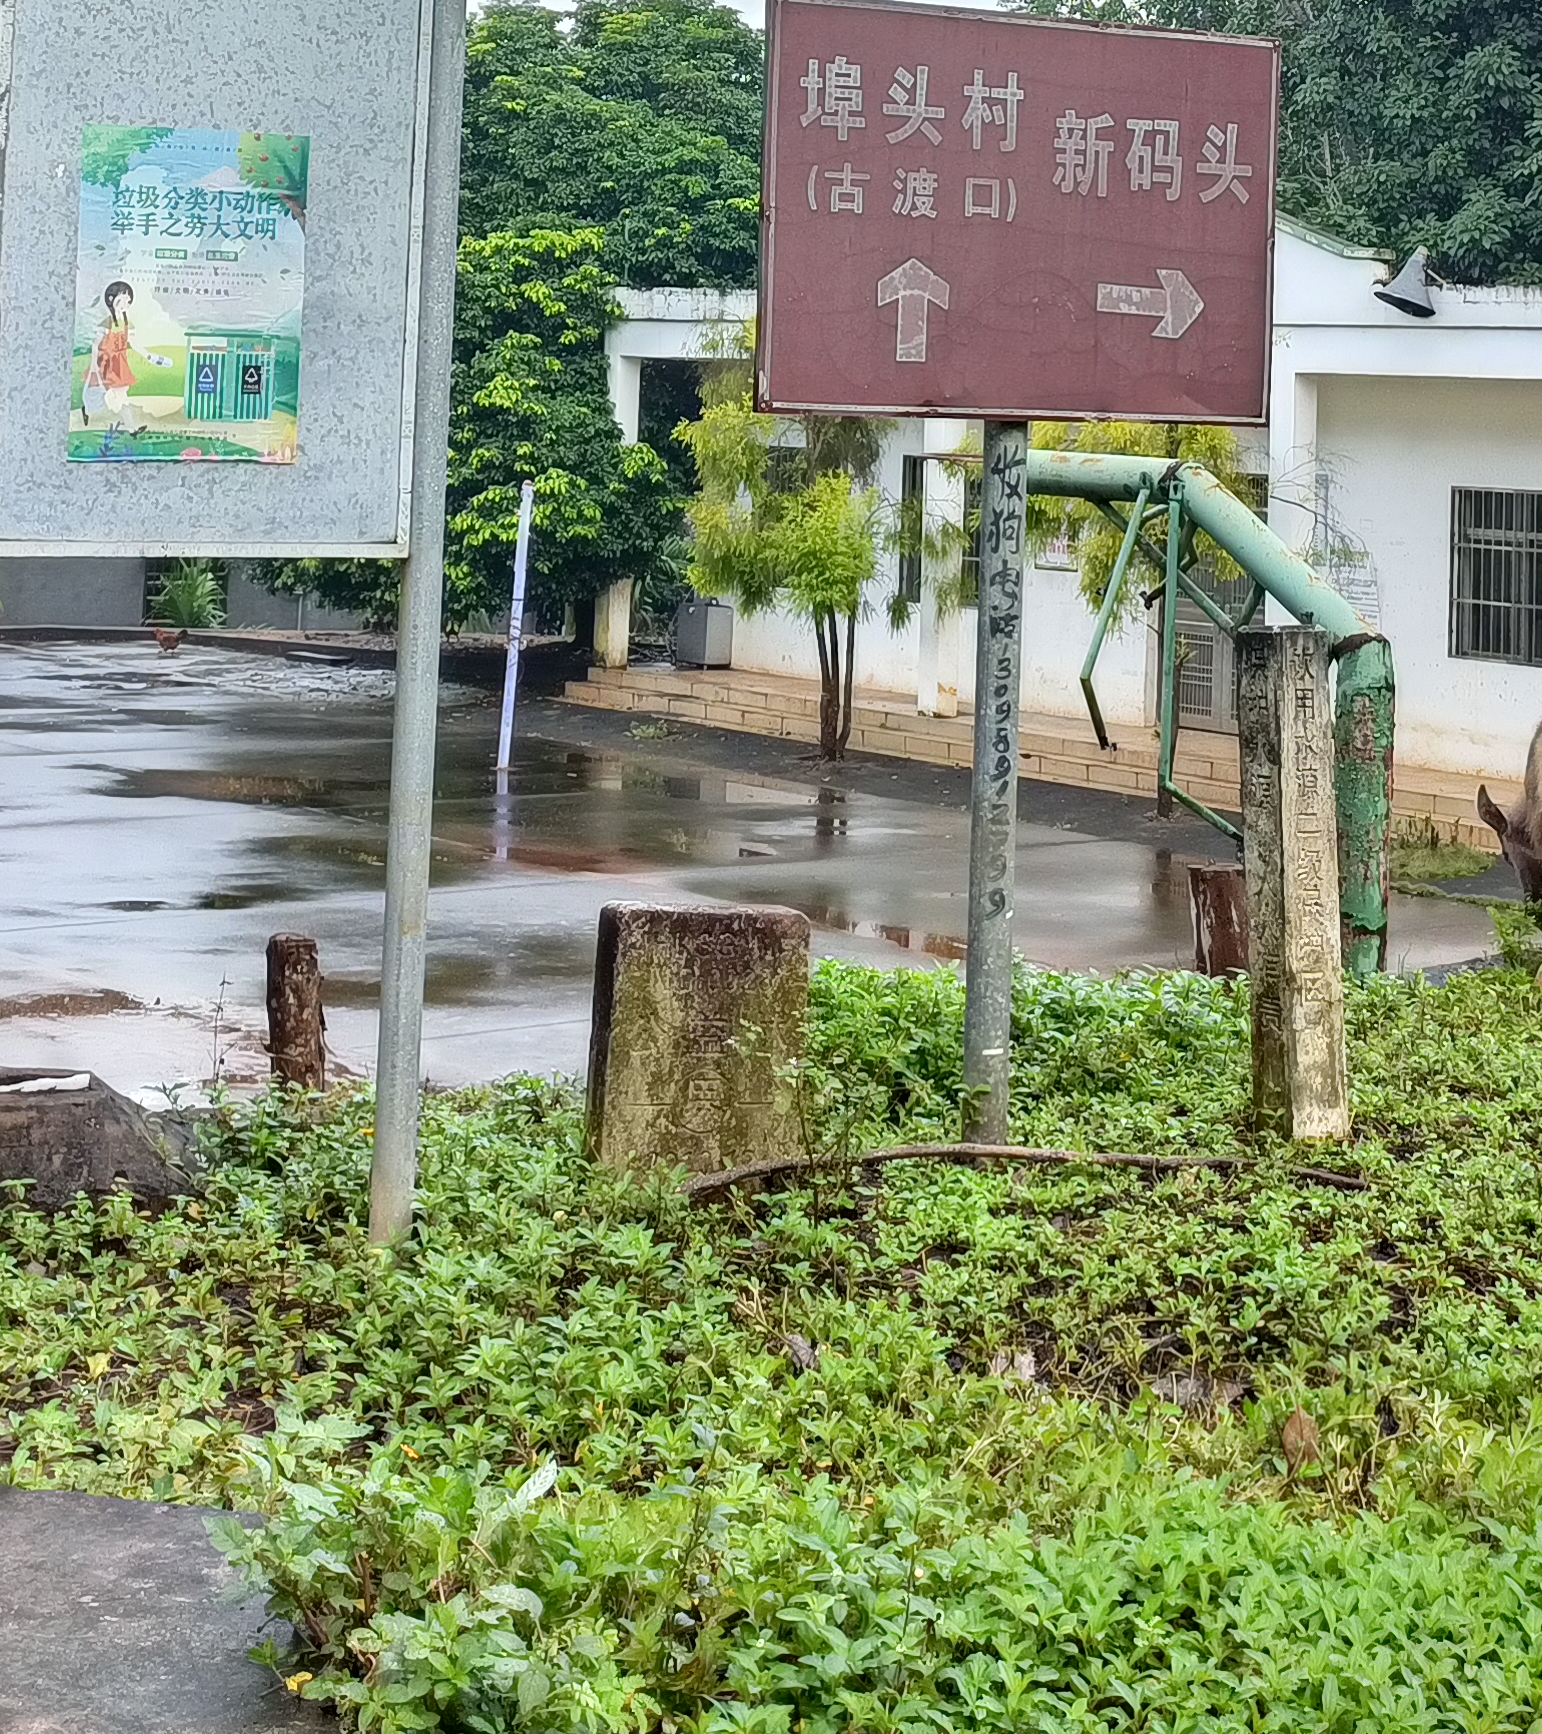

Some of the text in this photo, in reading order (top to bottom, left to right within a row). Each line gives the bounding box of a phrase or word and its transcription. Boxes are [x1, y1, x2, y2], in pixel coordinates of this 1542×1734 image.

[799, 56, 1024, 153] 埠头村
[1052, 109, 1252, 204] 新码头
[110, 210, 277, 241] 举手之劳大文明
[112, 184, 281, 215] 垃圾分类小动作
